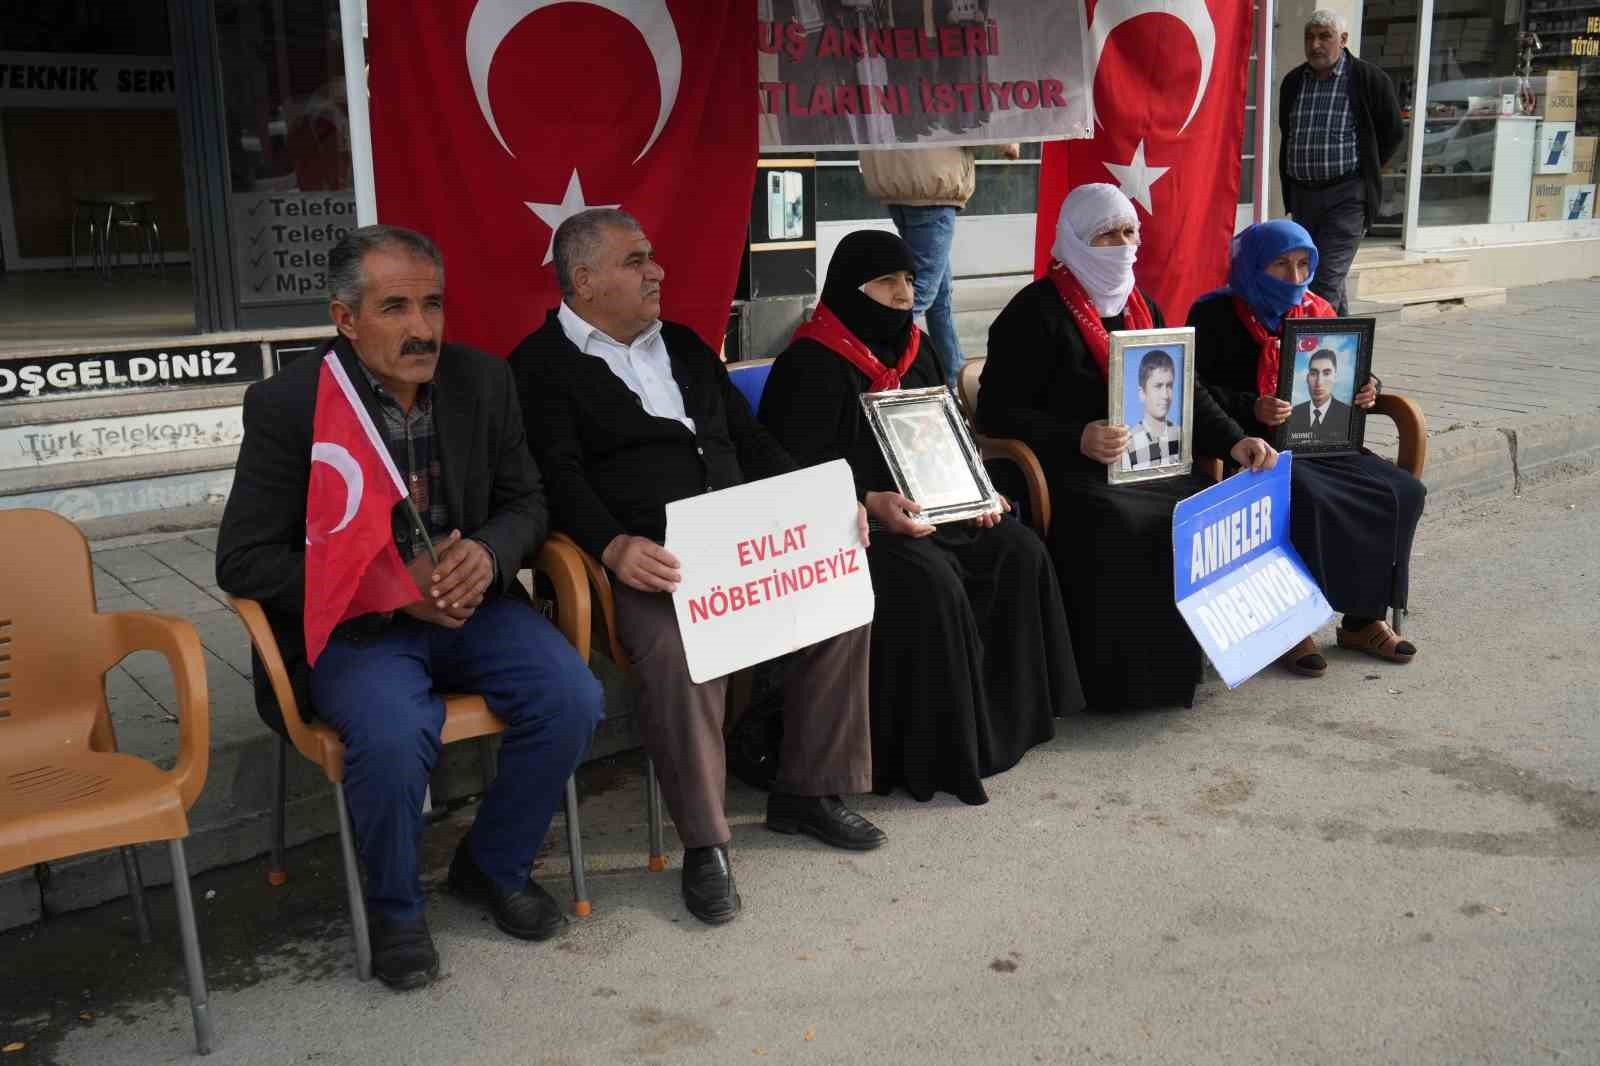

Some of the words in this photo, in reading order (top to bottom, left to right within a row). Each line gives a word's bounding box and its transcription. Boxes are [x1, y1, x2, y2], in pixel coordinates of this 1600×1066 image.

[1571, 36, 1599, 56] TÜTÜN
[757, 82, 910, 116] TLARINI
[920, 73, 1067, 114] İSTİYOR
[272, 224, 354, 242] Telefo
[276, 272, 327, 295] Mp3
[24, 429, 84, 452] Türk
[93, 421, 201, 447] Telekom
[736, 523, 808, 568] EVLAT
[1190, 495, 1272, 585] ANNELER
[687, 547, 860, 625] NÖBETİNDEYİZ
